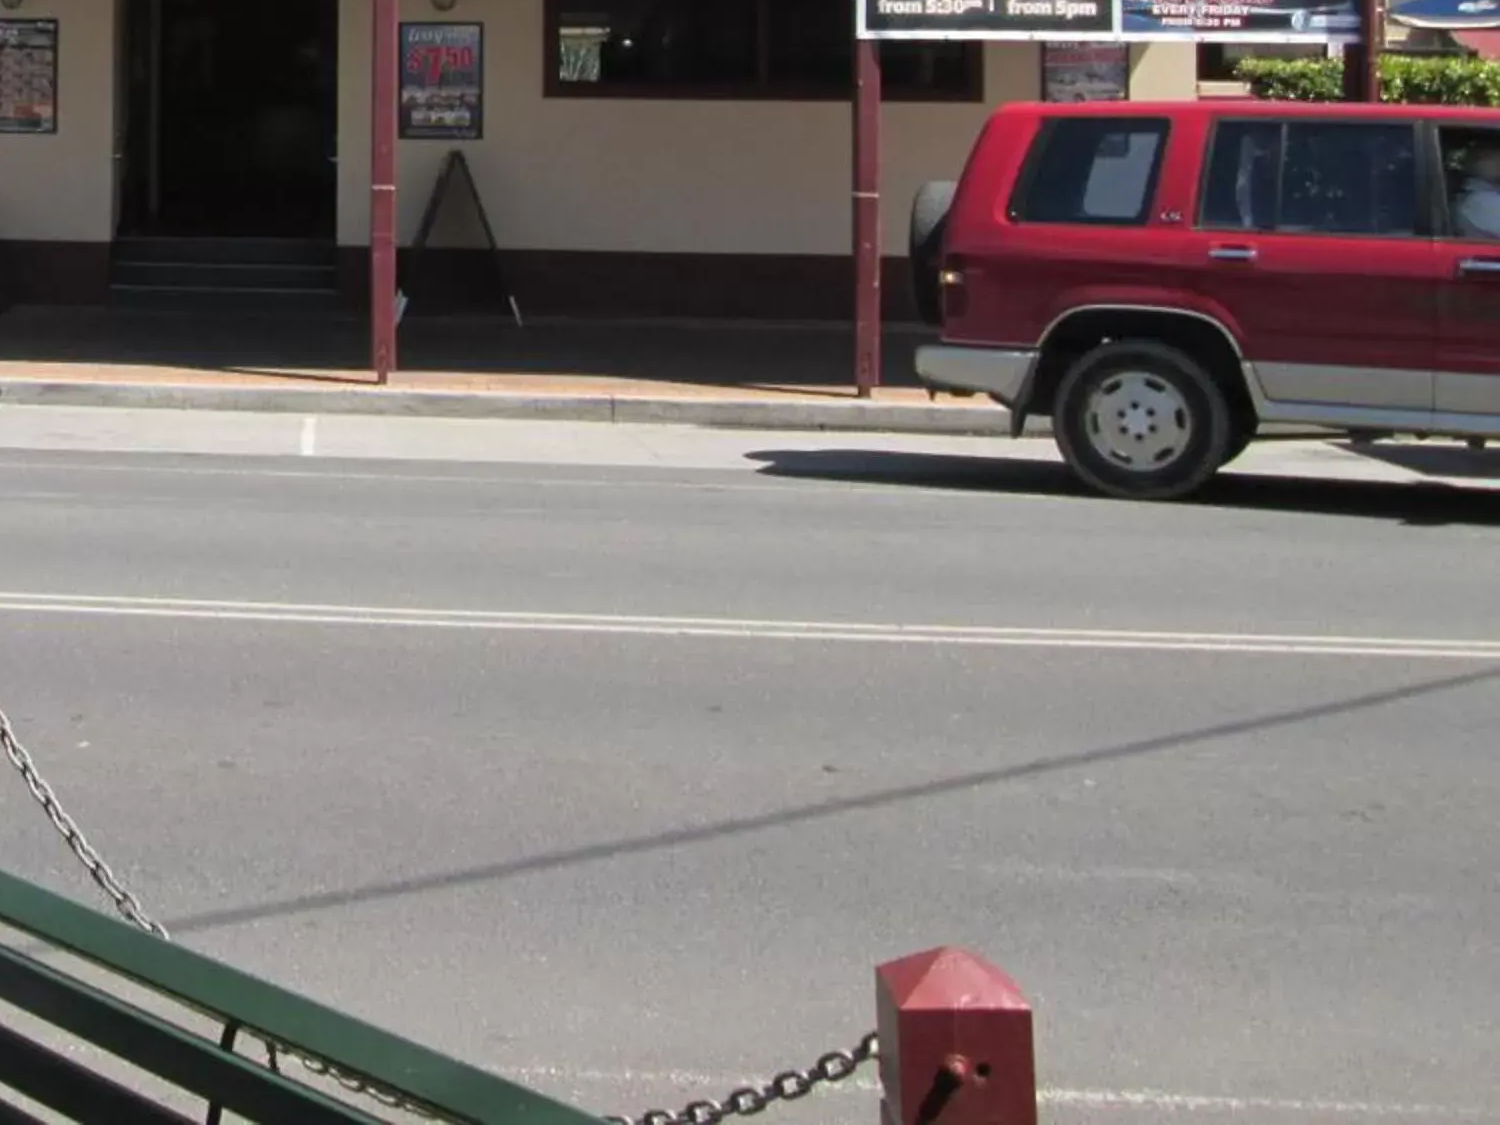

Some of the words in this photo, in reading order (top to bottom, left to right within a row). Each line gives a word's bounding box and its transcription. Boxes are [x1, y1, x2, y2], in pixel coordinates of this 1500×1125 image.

[1007, 0, 1052, 16] from
[1055, 1, 1098, 20] 5pm
[1201, 4, 1251, 16] FRIDAY
